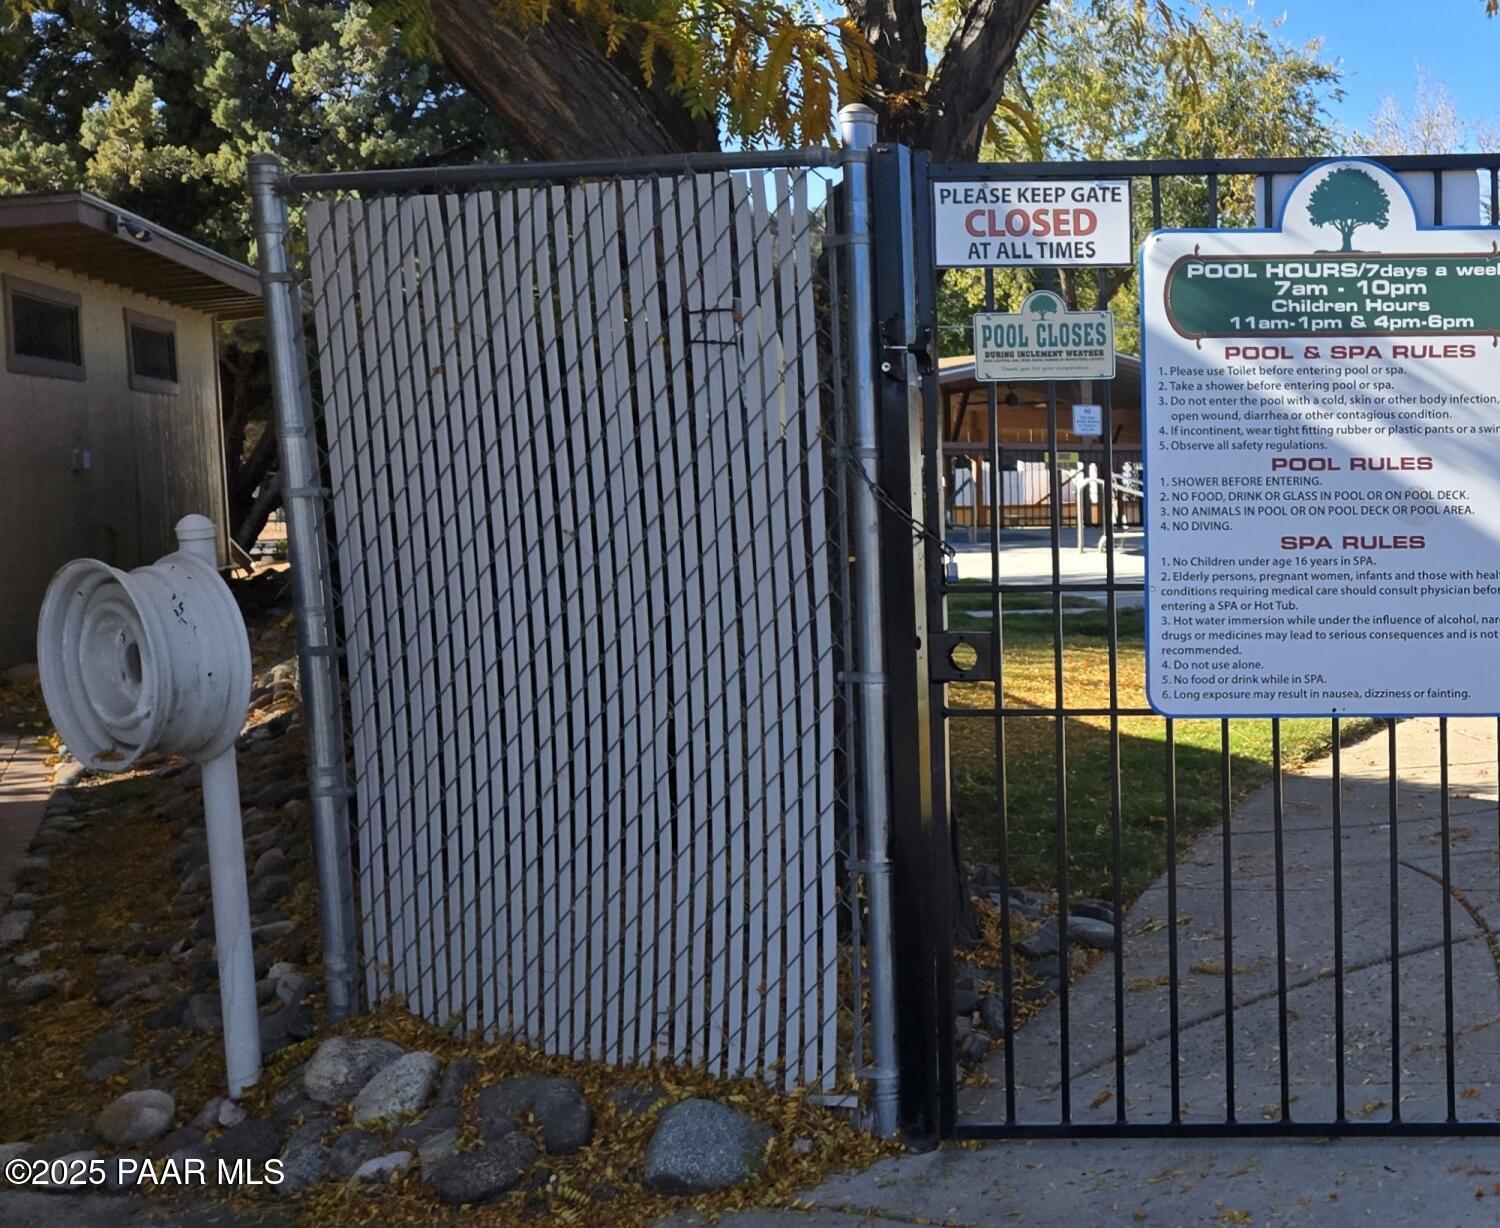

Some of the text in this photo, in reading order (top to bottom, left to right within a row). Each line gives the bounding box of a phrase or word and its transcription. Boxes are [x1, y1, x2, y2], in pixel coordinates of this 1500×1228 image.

[940, 187, 1121, 204] PLEASE KEEP GATE
[965, 208, 1097, 237] CLOSED
[968, 242, 1096, 259] AT ALL TIMES
[1187, 264, 1256, 278] POOL
[1266, 263, 1427, 279] HOURS/7days
[1436, 266, 1447, 276] a
[1274, 281, 1328, 295] 7am
[1356, 280, 1427, 297] 10pm
[1272, 299, 1430, 312] Children Hours
[1230, 315, 1474, 331] 11am-1pm & 4pm-6pm
[982, 323, 1106, 348] POOL CLOSES
[1225, 345, 1476, 360] POOL & SPA RULES
[1159, 366, 1167, 375] 1.
[1170, 366, 1204, 375] Please
[1227, 366, 1255, 375] Toilet
[1259, 365, 1294, 375] before
[1296, 366, 1341, 377] entering
[1345, 365, 1368, 377] pool
[1386, 367, 1406, 376] spa.
[1159, 383, 1167, 392] 2.
[1169, 382, 1194, 392] Take
[1206, 382, 1244, 391] shower
[1248, 381, 1281, 391] before
[1284, 382, 1329, 393] entering
[1332, 381, 1356, 392] pool
[1373, 382, 1394, 392] spa.
[1159, 441, 1327, 453] 5. Observe all safety regulations.
[1272, 457, 1432, 471] POOL RULES
[1160, 477, 1322, 486] 1. SHOWER BEFORE ENTERING.
[1160, 491, 1469, 502] 2. NO FOOD, DRINK OR GLASS IN POOL OR ON POOL DECK.
[1160, 521, 1232, 530] 4. NO DIVING.
[1281, 536, 1425, 550] SPA RULES
[1162, 556, 1376, 568] 1. No Children under age 16 years in SPA.
[1161, 572, 1170, 581] 2.
[1173, 572, 1209, 583] Elderly
[1212, 574, 1256, 583] persons,
[1260, 572, 1308, 583] pregnant
[1311, 573, 1353, 582] women,
[1356, 571, 1392, 580] infants
[1395, 571, 1414, 580] and
[1418, 571, 1447, 580] those
[1450, 570, 1473, 580] with
[1162, 616, 1170, 625] 3.
[1174, 616, 1192, 625] Hot
[1195, 616, 1225, 625] water
[1228, 616, 1284, 625] immersion
[1287, 615, 1316, 624] while
[1319, 615, 1350, 624] under
[1353, 615, 1370, 624] the
[1373, 615, 1421, 624] influence
[1424, 615, 1435, 624] of
[1438, 615, 1478, 626] alcohol,
[1162, 645, 1242, 654] recommended.
[1162, 660, 1170, 669] 4.
[1174, 660, 1188, 669] Do
[1192, 661, 1209, 669] not
[1232, 660, 1264, 669] alone.
[1162, 675, 1171, 684] 5.
[1174, 675, 1188, 684] No
[1191, 675, 1215, 684] food
[1232, 675, 1258, 684] drink
[1261, 675, 1289, 684] while
[1292, 675, 1301, 684] in
[1304, 674, 1326, 684] SPA.
[1162, 690, 1172, 699] 6.
[1174, 690, 1200, 701] Long
[1203, 692, 1250, 701] exposure
[1254, 692, 1275, 701] may
[1278, 689, 1307, 698] result
[1310, 690, 1319, 698] in
[1322, 691, 1362, 700] nausea,
[1365, 689, 1411, 698] dizziness
[1428, 689, 1470, 700] fainting.
